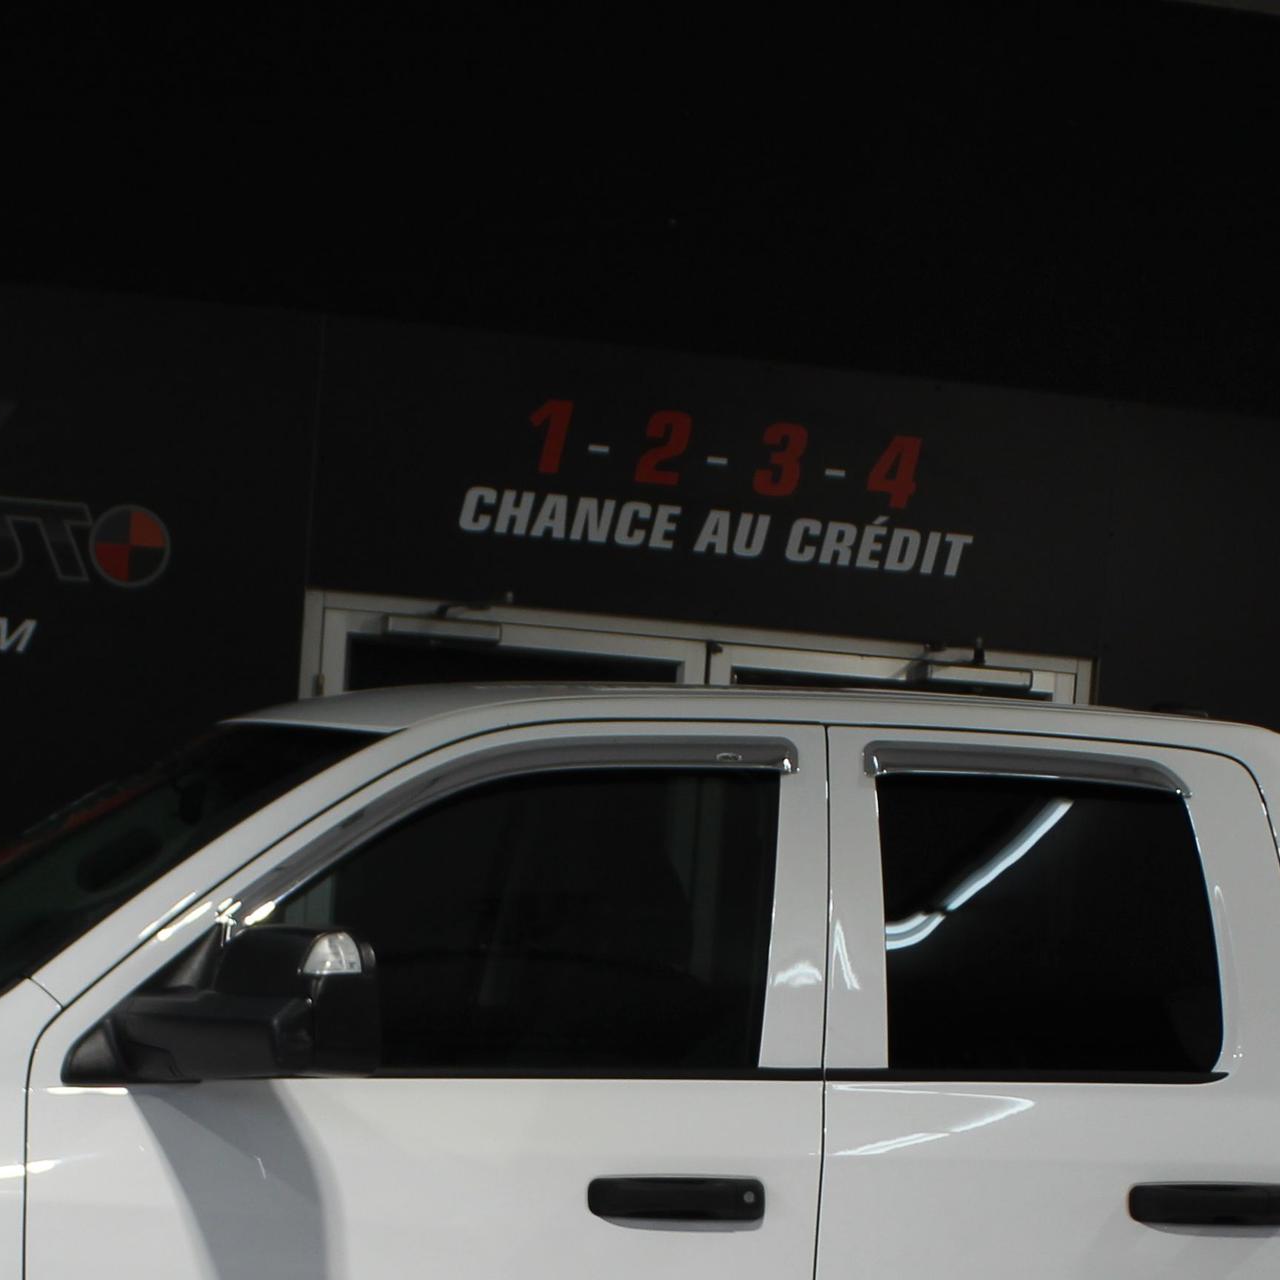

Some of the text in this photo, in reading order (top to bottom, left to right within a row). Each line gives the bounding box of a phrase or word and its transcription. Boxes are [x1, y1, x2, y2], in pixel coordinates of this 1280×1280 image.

[458, 486, 974, 578] CHANCE AU CRÉDIT
